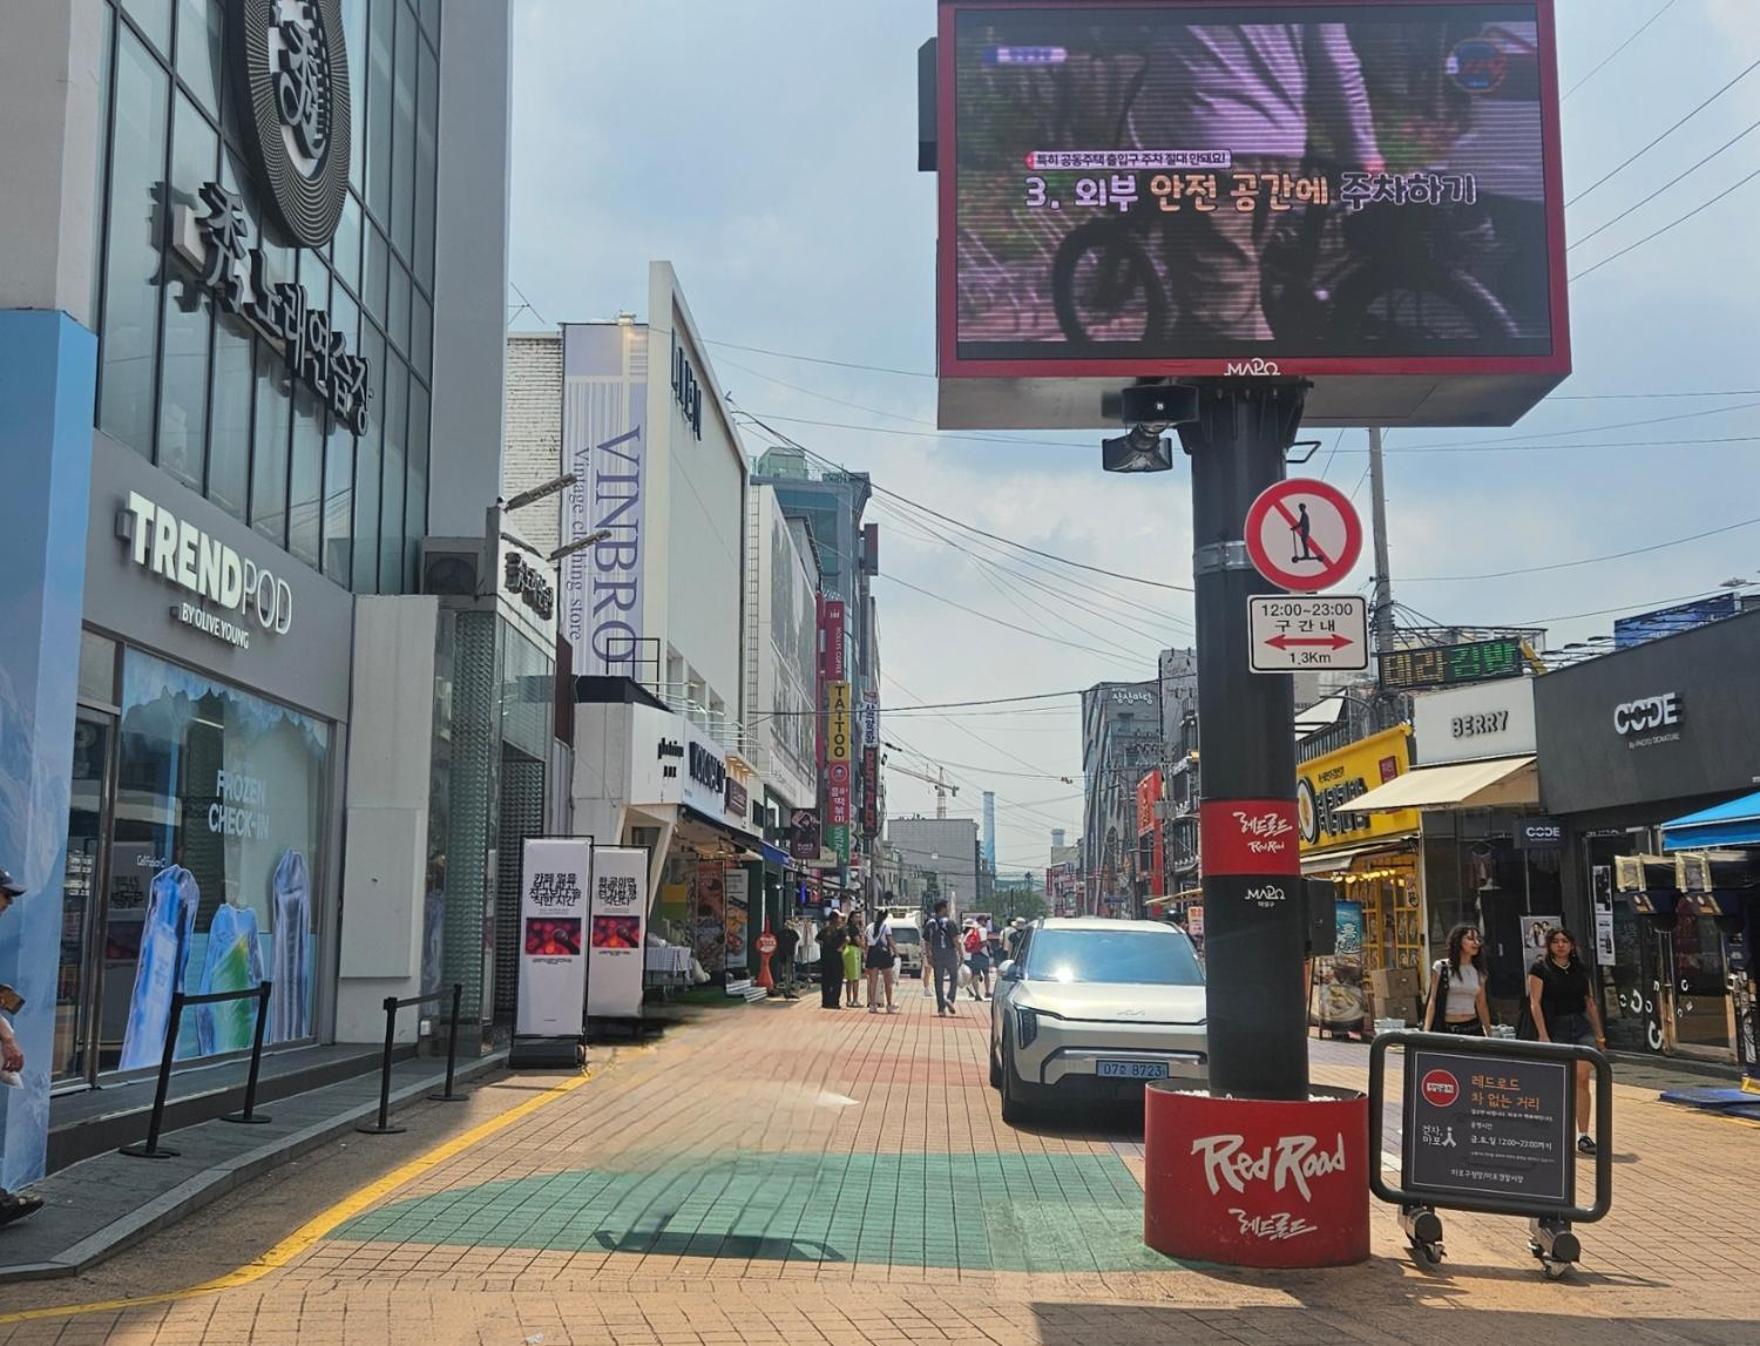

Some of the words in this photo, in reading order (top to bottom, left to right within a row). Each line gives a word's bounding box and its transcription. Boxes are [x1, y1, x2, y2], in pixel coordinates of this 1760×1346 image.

[1025, 176, 1060, 210] 3.
[1074, 174, 1139, 213] 외부
[1150, 174, 1217, 212] 안전
[1230, 173, 1328, 212] 공간에
[1340, 171, 1478, 211] 주차하기
[569, 447, 590, 514] Vintage
[567, 521, 588, 591] clhing
[591, 425, 641, 663] VINBRO
[182, 602, 195, 626] BY
[195, 608, 220, 636] OLIVE
[221, 619, 249, 649] YOUNG
[569, 598, 584, 640] store
[1261, 603, 1353, 617] 12:00~23:00
[1289, 652, 1331, 665] 1.3Km
[834, 686, 845, 758] TATTOO
[1453, 710, 1509, 738] BERRY
[1614, 691, 1679, 735] CODE
[216, 769, 267, 806] FROZEN
[208, 803, 269, 840] CHECK-IN
[1525, 826, 1561, 838] CODE
[1131, 1063, 1162, 1077] 8723
[1488, 1093, 1513, 1109] 없는
[1517, 1096, 1540, 1112] 거리
[1190, 1134, 1272, 1195] Red
[1275, 1131, 1346, 1202] Road
